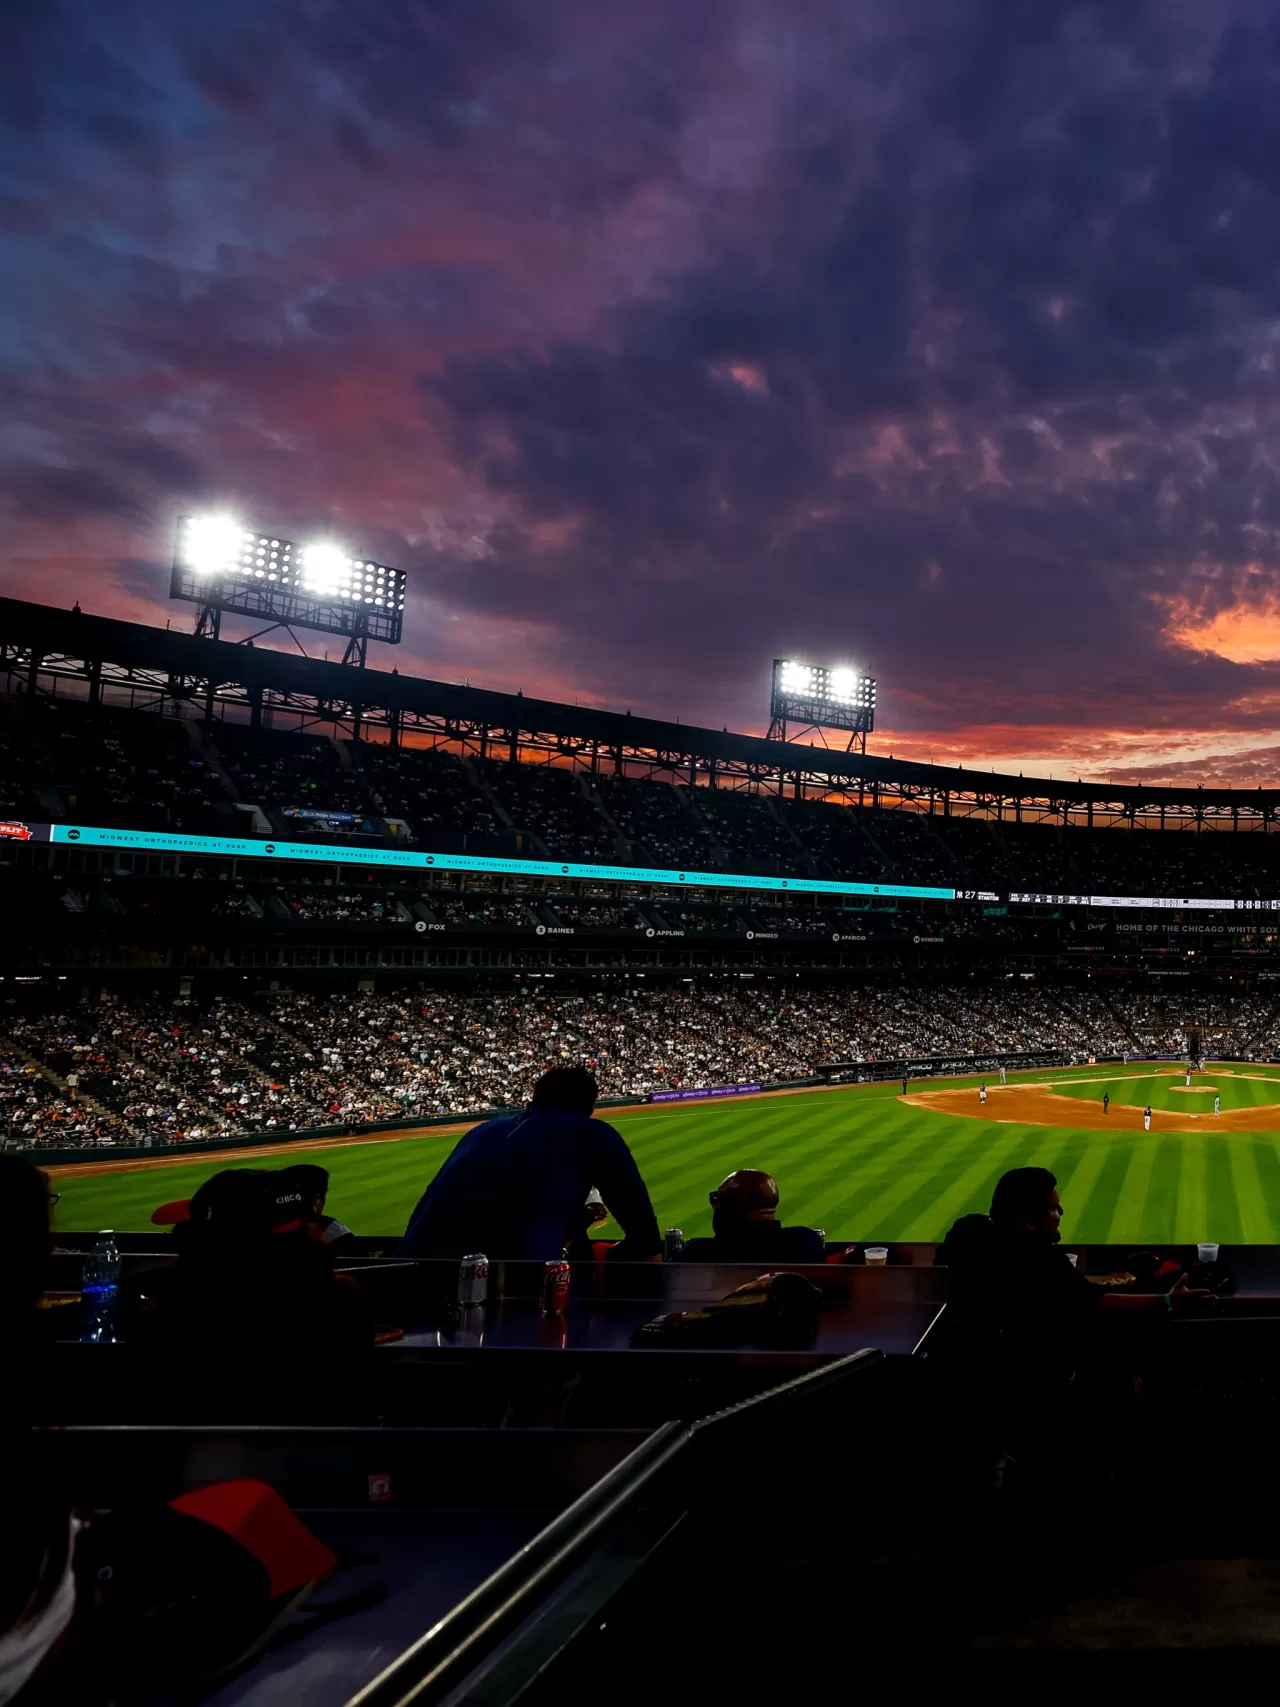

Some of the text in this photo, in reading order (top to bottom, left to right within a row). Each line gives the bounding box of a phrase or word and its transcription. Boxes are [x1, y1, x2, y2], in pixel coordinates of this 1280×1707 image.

[100, 834, 140, 842] MIDWEST
[145, 837, 208, 847] ORTHOPAEDICS
[327, 850, 378, 859] ORTHOPAEDICS
[965, 891, 976, 899] 27
